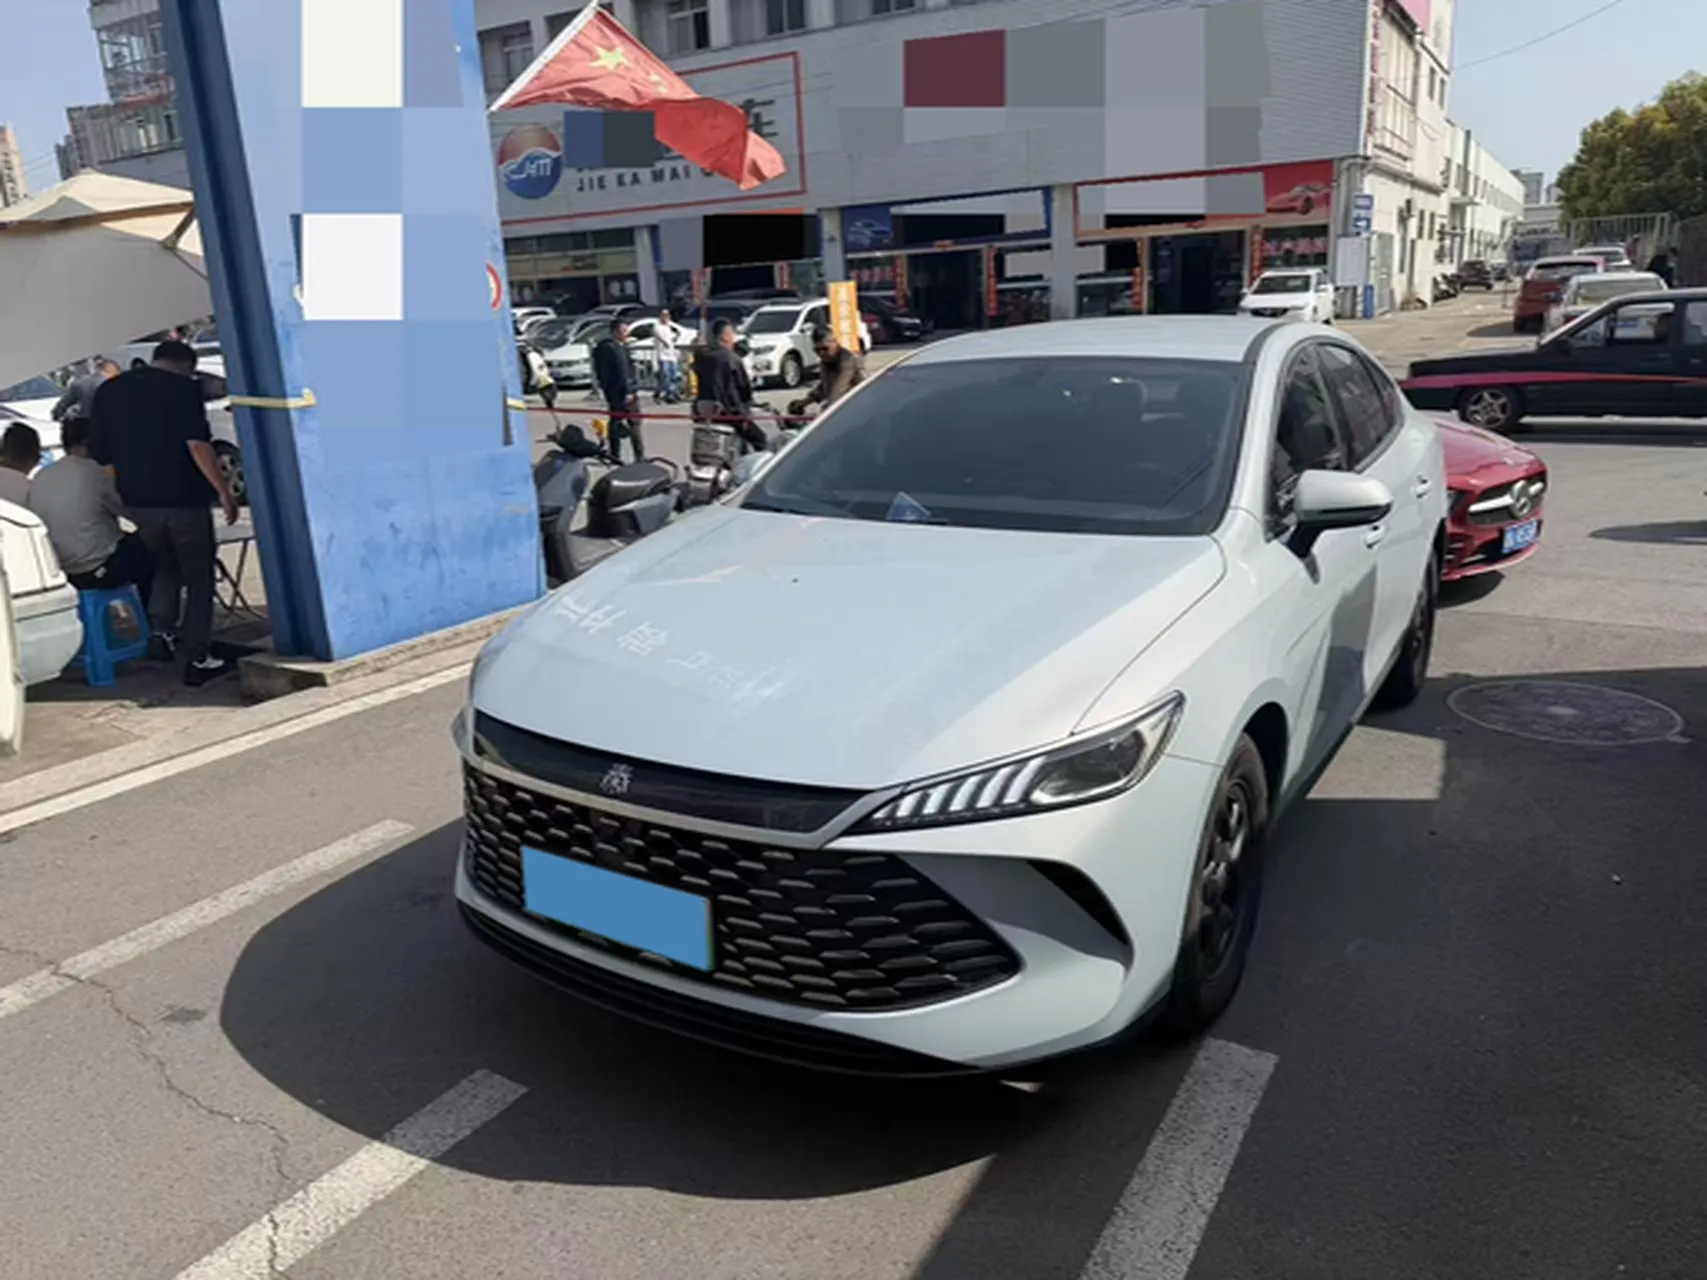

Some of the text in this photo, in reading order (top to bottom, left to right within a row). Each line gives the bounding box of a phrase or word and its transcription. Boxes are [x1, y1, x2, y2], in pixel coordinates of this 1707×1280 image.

[576, 174, 607, 192] JIE
[616, 171, 642, 187] KA
[651, 164, 692, 184] MAI
